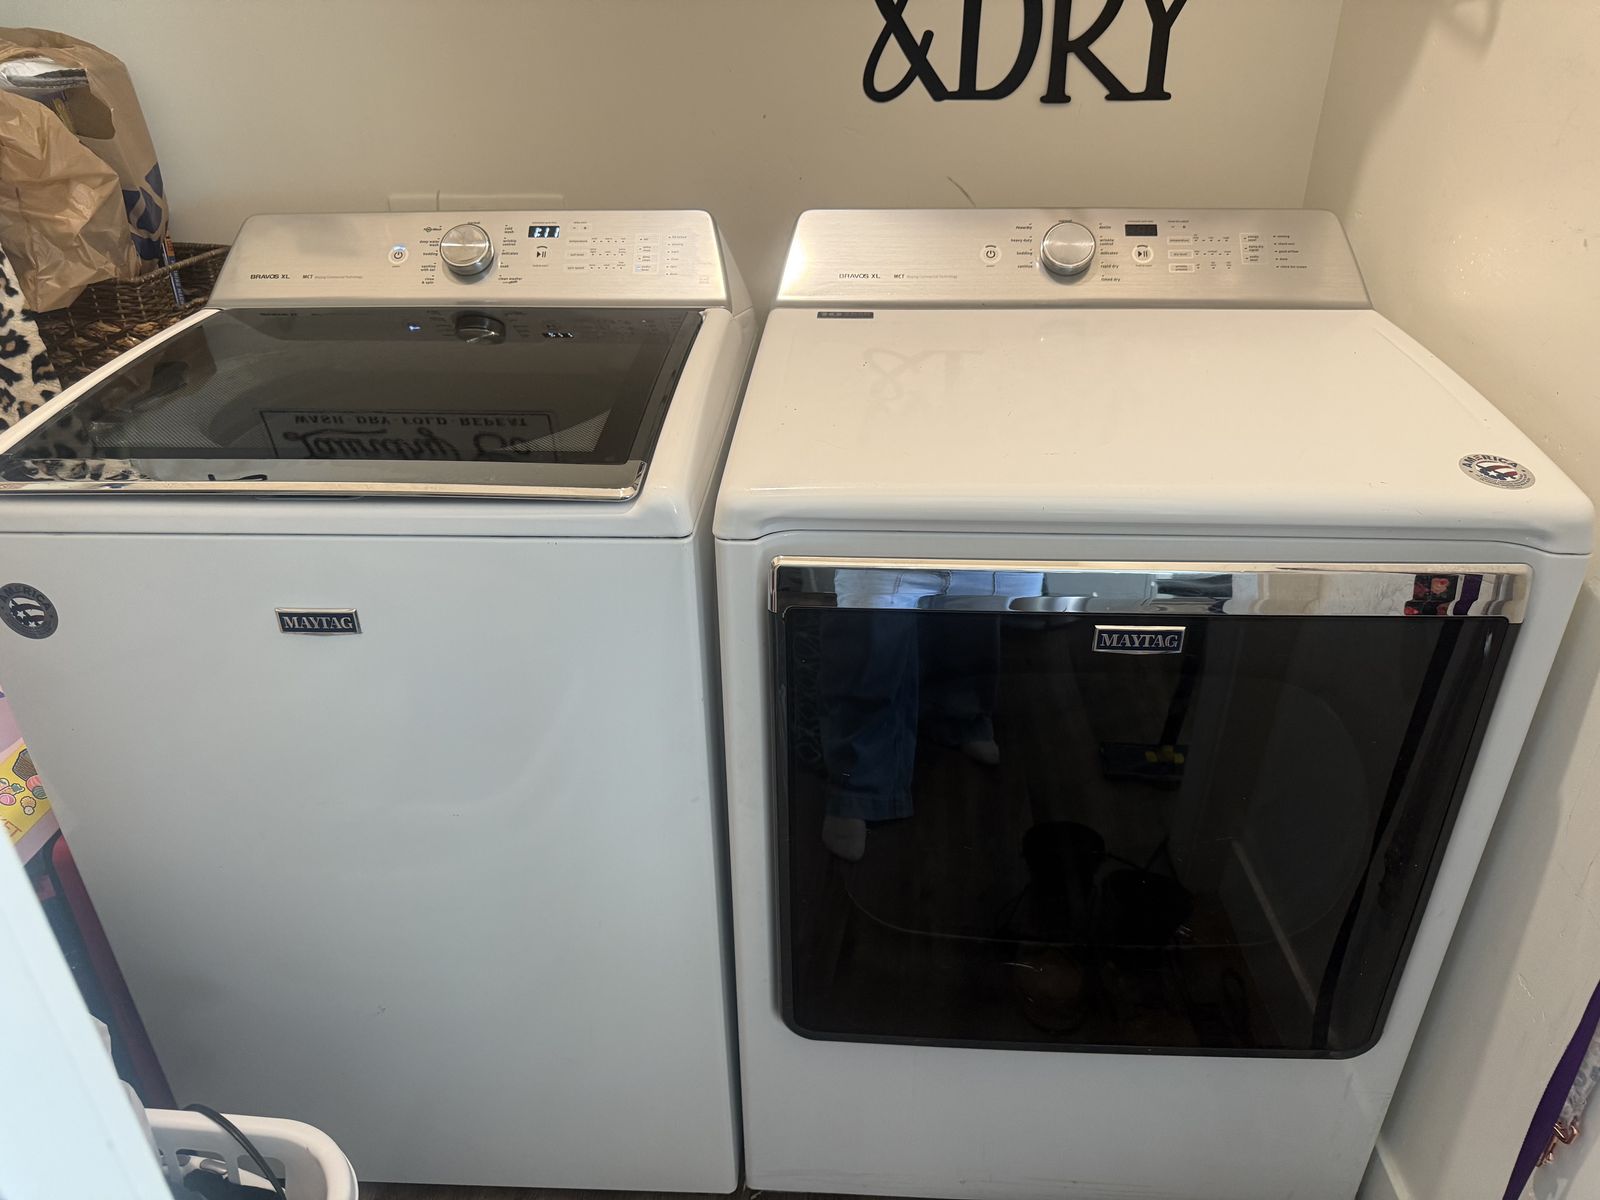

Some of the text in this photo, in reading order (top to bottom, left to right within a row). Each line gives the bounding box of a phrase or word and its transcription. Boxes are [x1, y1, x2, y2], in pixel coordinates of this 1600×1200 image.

[1462, 454, 1518, 468] AMERICA
[283, 616, 353, 629] MAYTAG
[1099, 633, 1178, 647] MAYTAG
